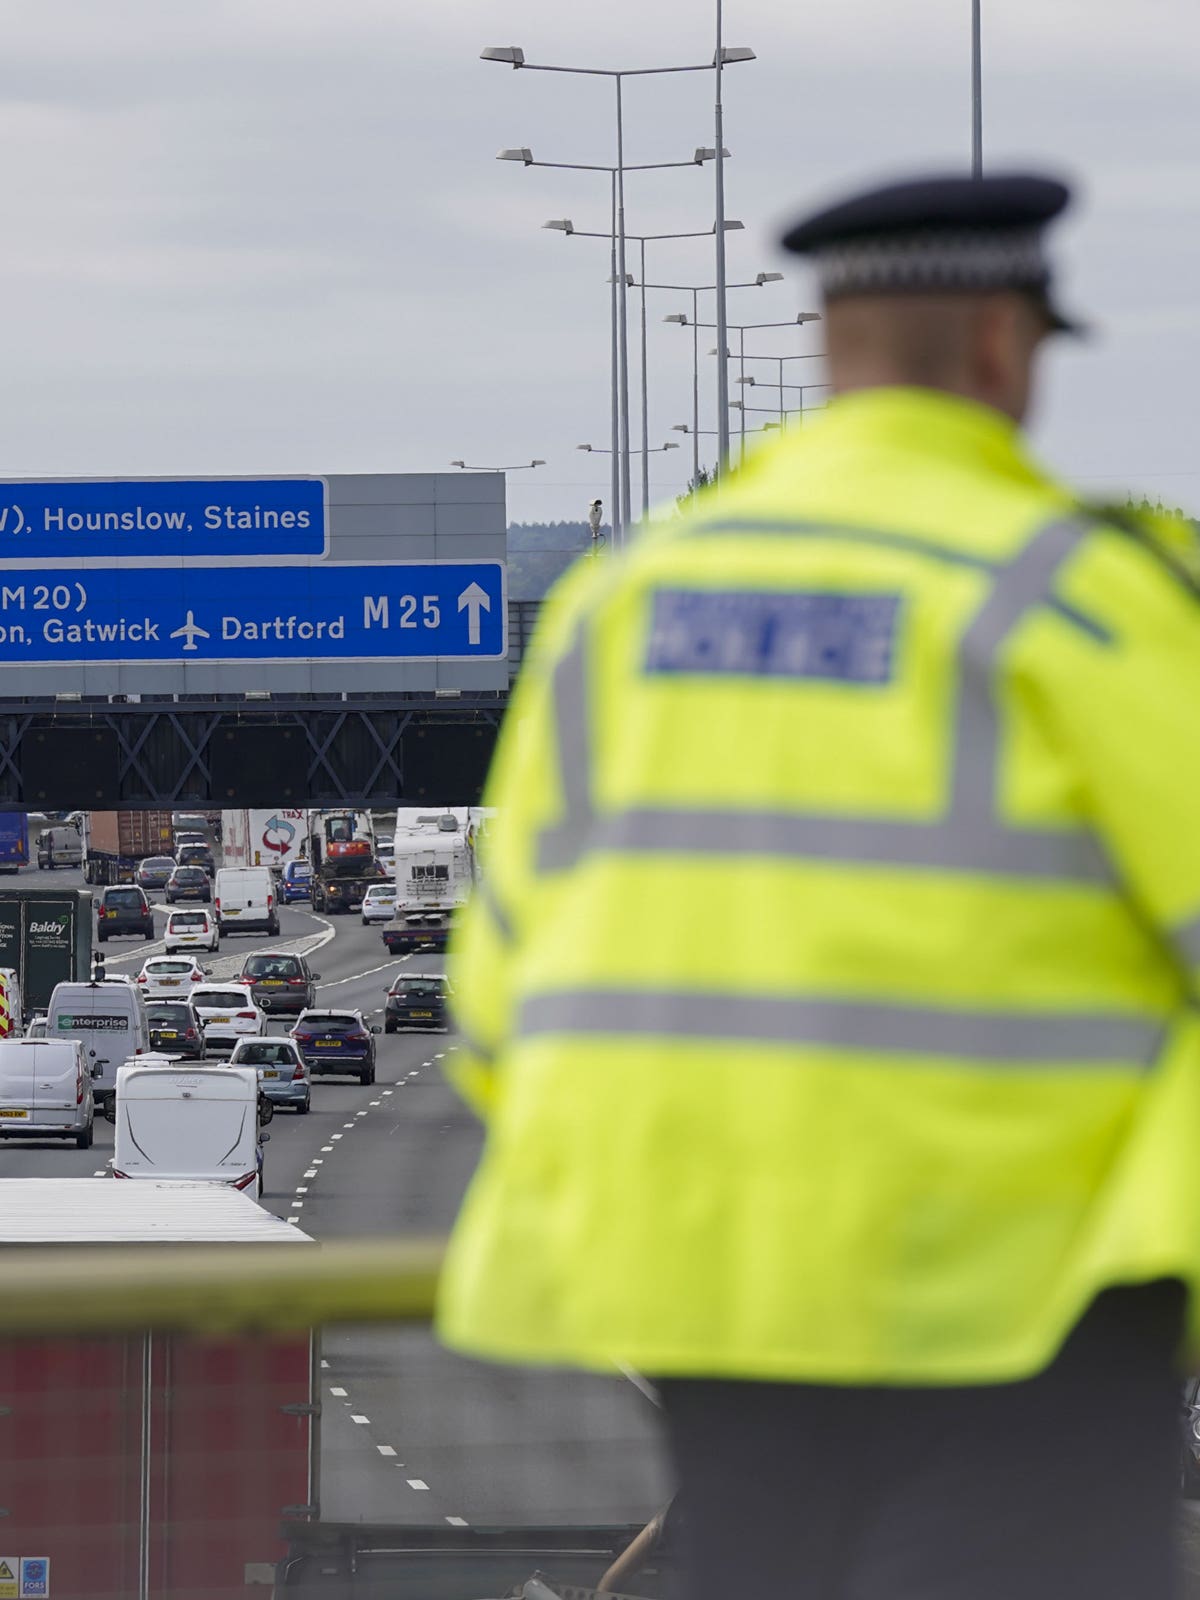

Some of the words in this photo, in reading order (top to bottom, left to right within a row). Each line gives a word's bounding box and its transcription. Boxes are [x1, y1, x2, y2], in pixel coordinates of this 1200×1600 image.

[44, 506, 193, 533] Hounslow,
[204, 505, 311, 530] Staines
[43, 618, 160, 643] Gatwick
[222, 615, 345, 641] Dartford
[30, 921, 66, 935] Baldry
[60, 1017, 128, 1029] enterprise
